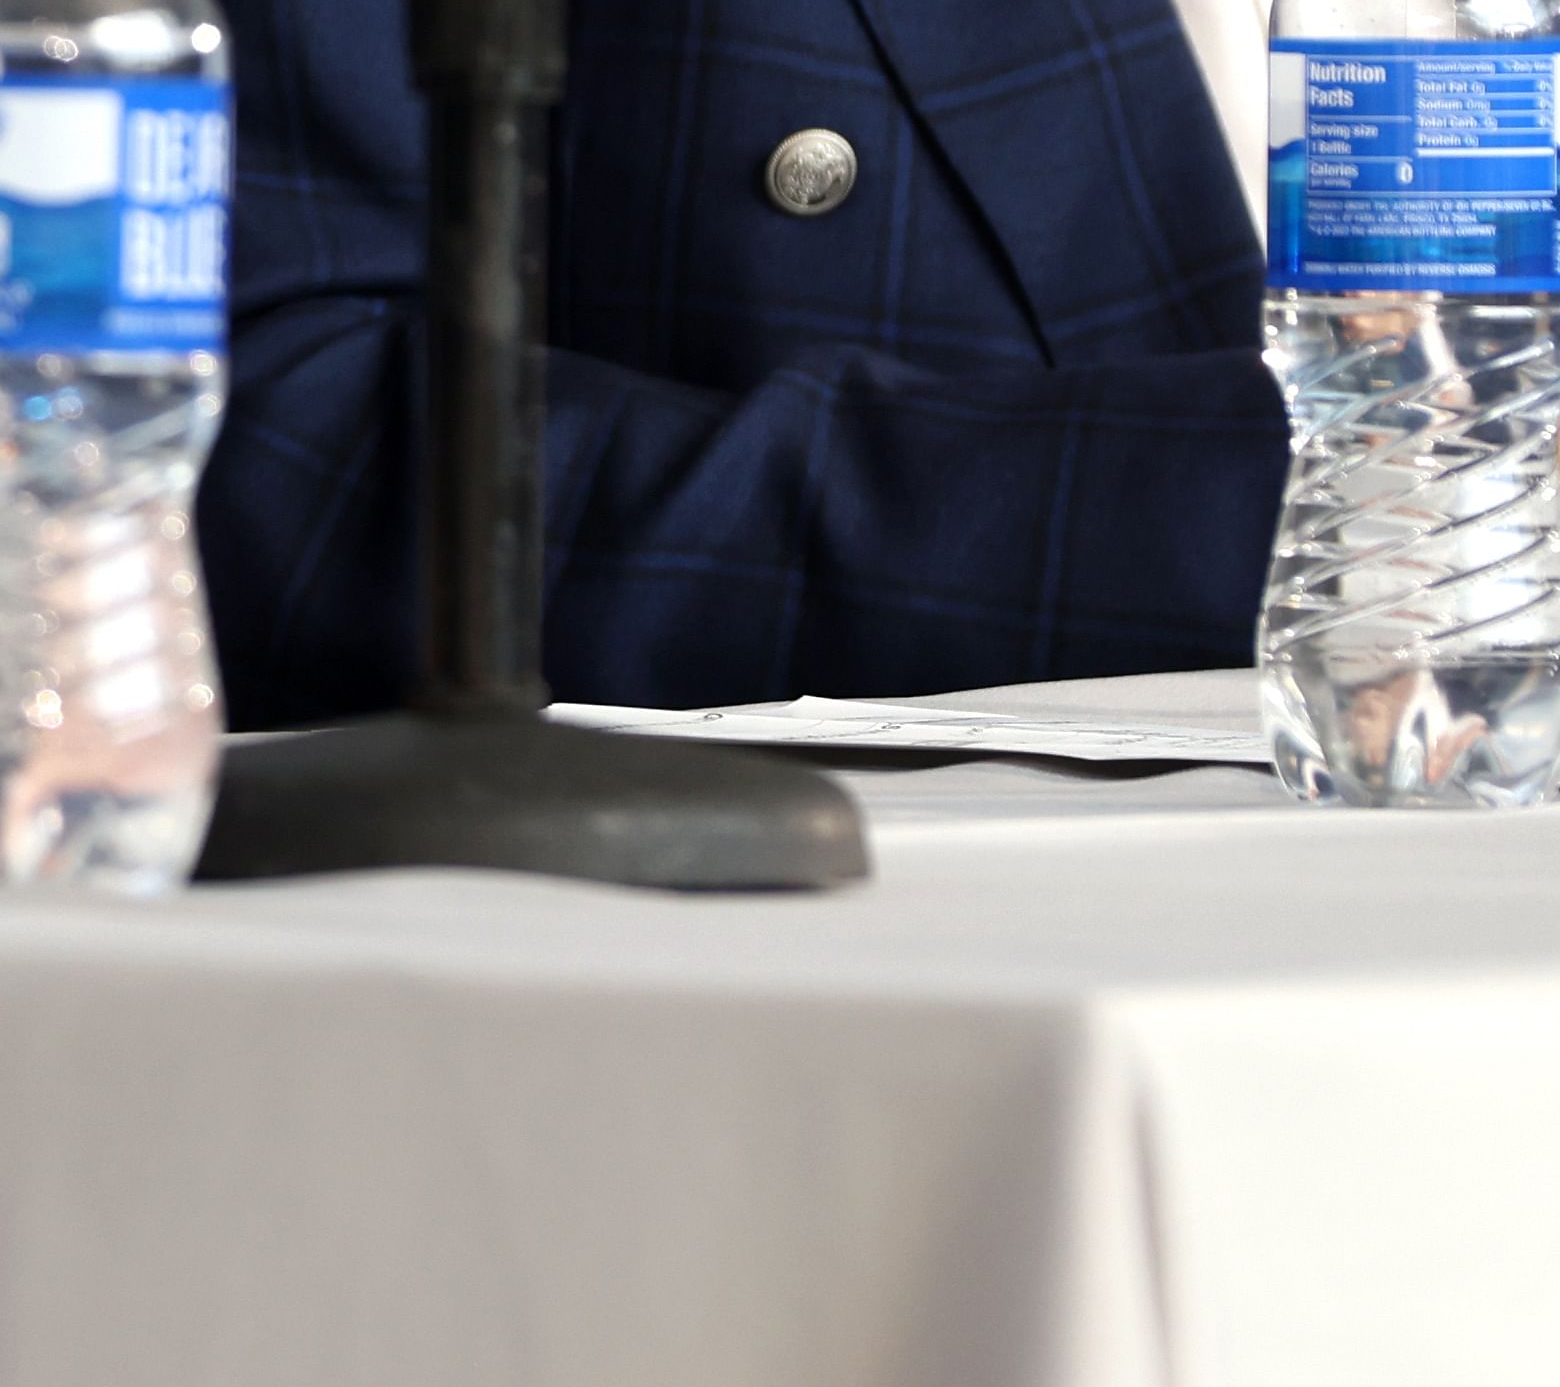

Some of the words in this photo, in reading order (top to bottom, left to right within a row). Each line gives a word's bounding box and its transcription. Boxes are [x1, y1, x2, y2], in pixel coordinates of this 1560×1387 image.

[1310, 62, 1386, 82] Nutrition
[1419, 80, 1446, 92] Total
[1310, 85, 1354, 107] Facts
[1419, 98, 1463, 110] Sodium
[1311, 123, 1350, 139] Serving
[1354, 124, 1379, 137] size
[1419, 134, 1461, 146] Protein
[1311, 162, 1359, 178] Calories
[1397, 162, 1413, 184] 0
